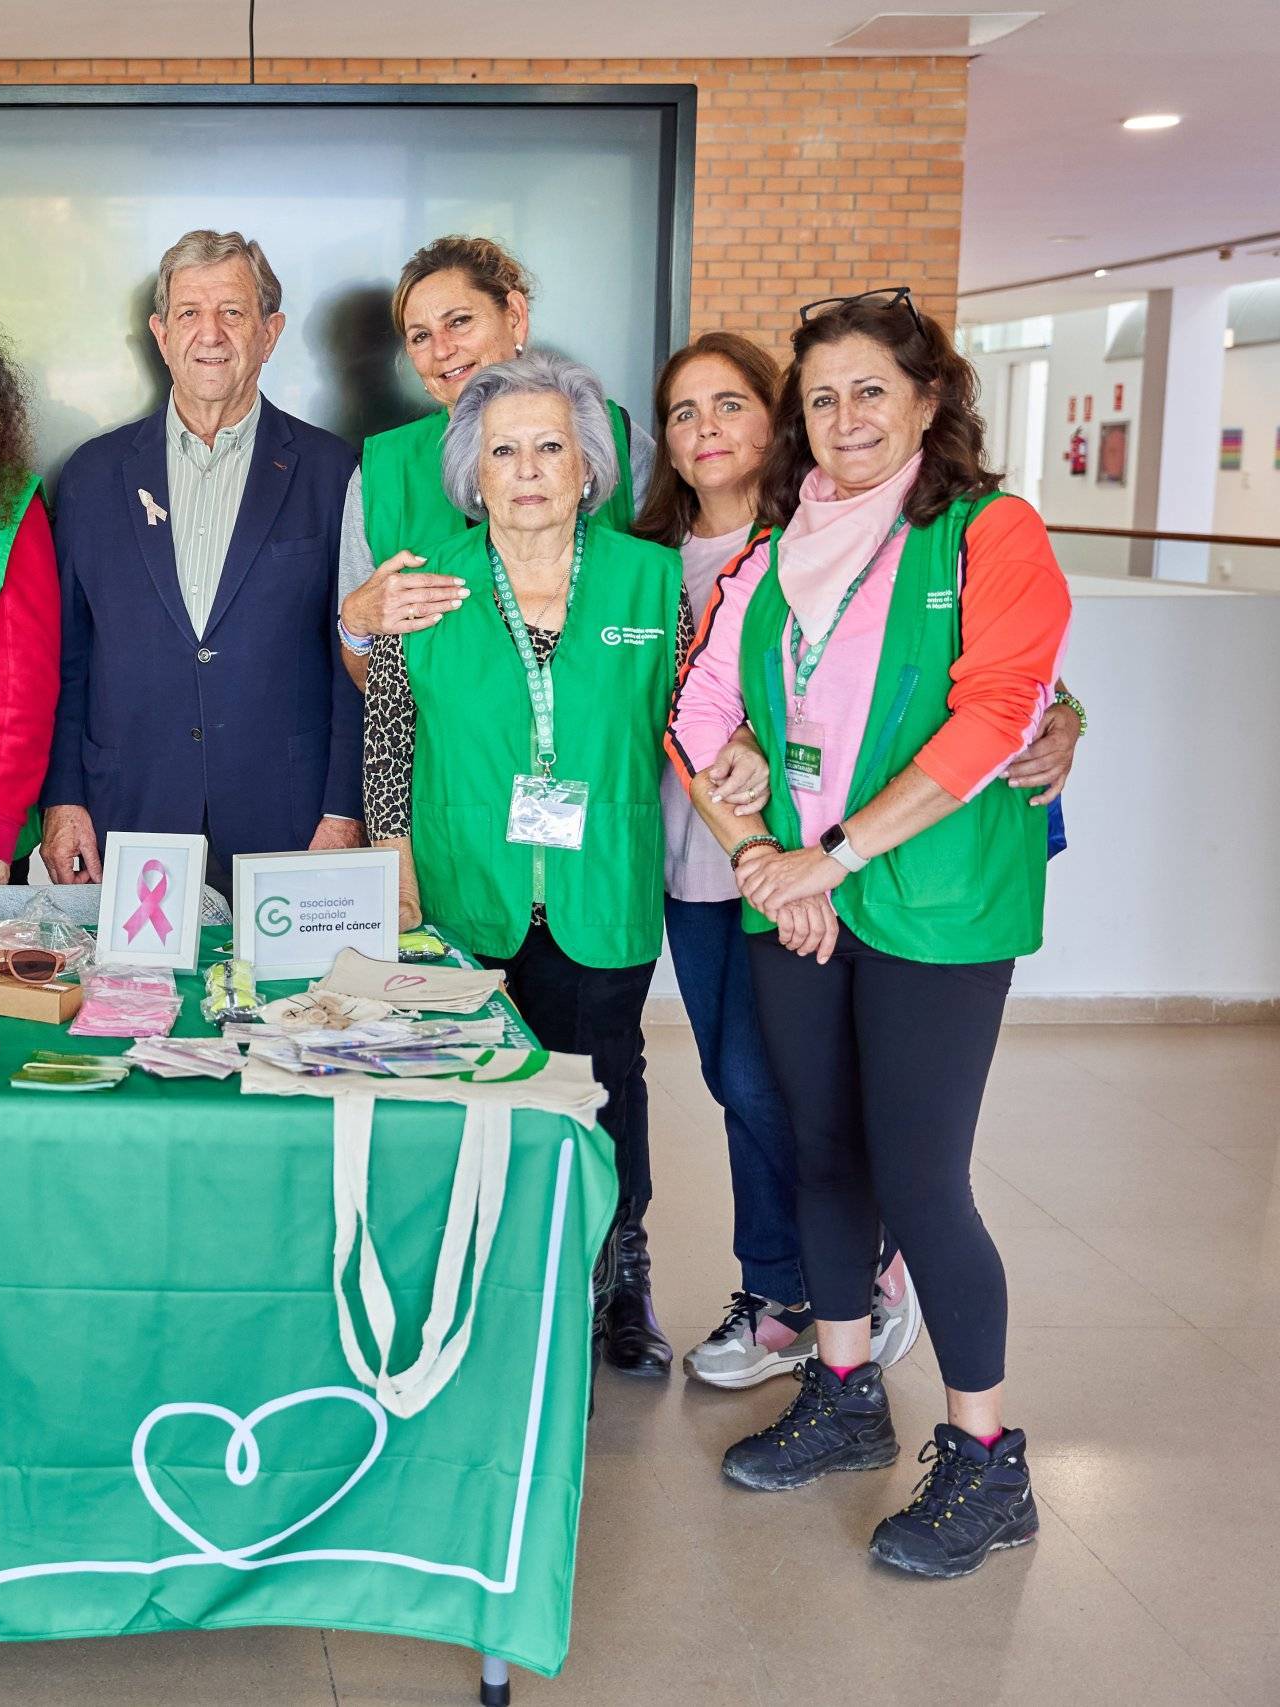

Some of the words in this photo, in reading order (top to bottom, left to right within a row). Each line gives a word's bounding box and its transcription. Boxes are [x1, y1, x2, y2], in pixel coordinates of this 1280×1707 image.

[300, 897, 354, 908] asociación
[300, 909, 346, 922] española
[299, 923, 332, 933] contra
[335, 921, 344, 931] el
[347, 921, 381, 931] cáncer
